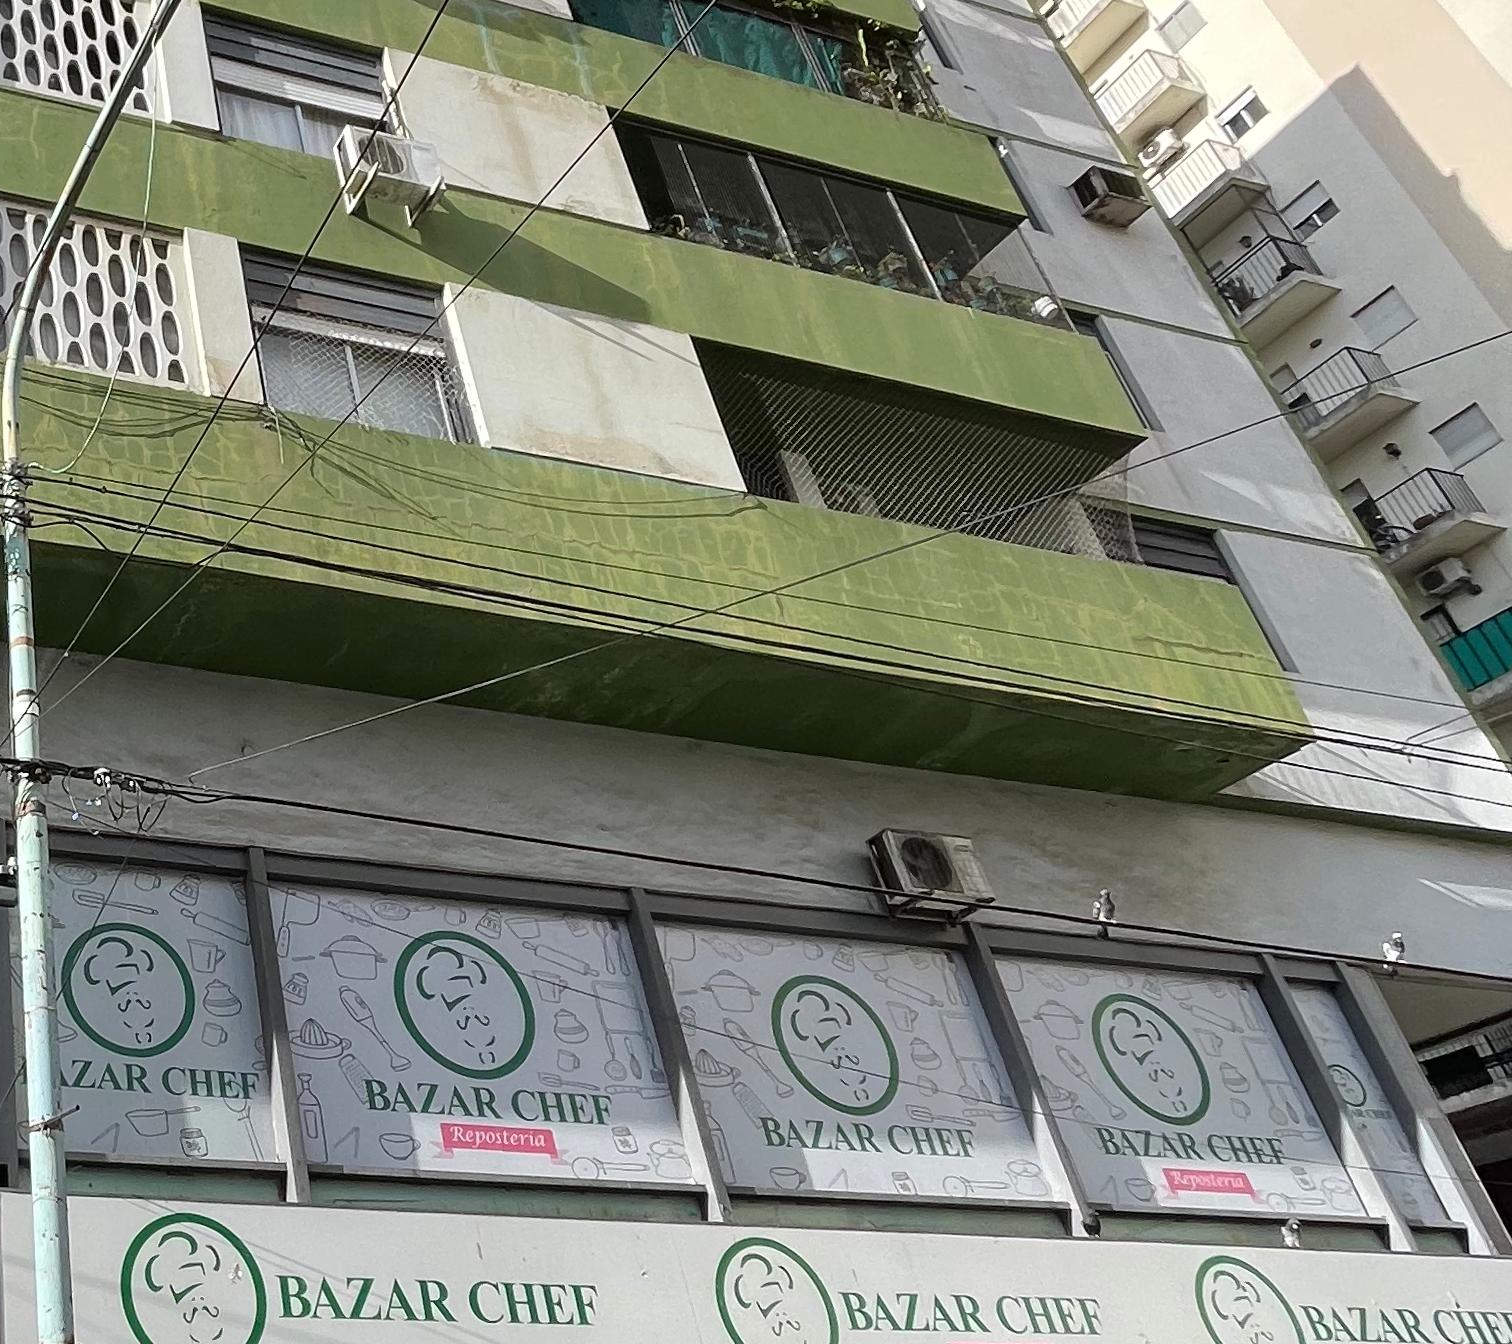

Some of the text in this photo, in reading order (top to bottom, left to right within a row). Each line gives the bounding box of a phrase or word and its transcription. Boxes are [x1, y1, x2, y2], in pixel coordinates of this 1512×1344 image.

[161, 1066, 259, 1099] CHEF
[365, 1079, 612, 1125] BAZAR CHEF
[759, 1116, 976, 1157] BAZAR CHEF
[1095, 1127, 1285, 1165] BAZAR CHEF
[274, 1274, 598, 1326] BAZAR CHEF
[839, 1291, 1103, 1335] BAZAR CHEF
[1298, 1304, 1434, 1344] BAZAR
